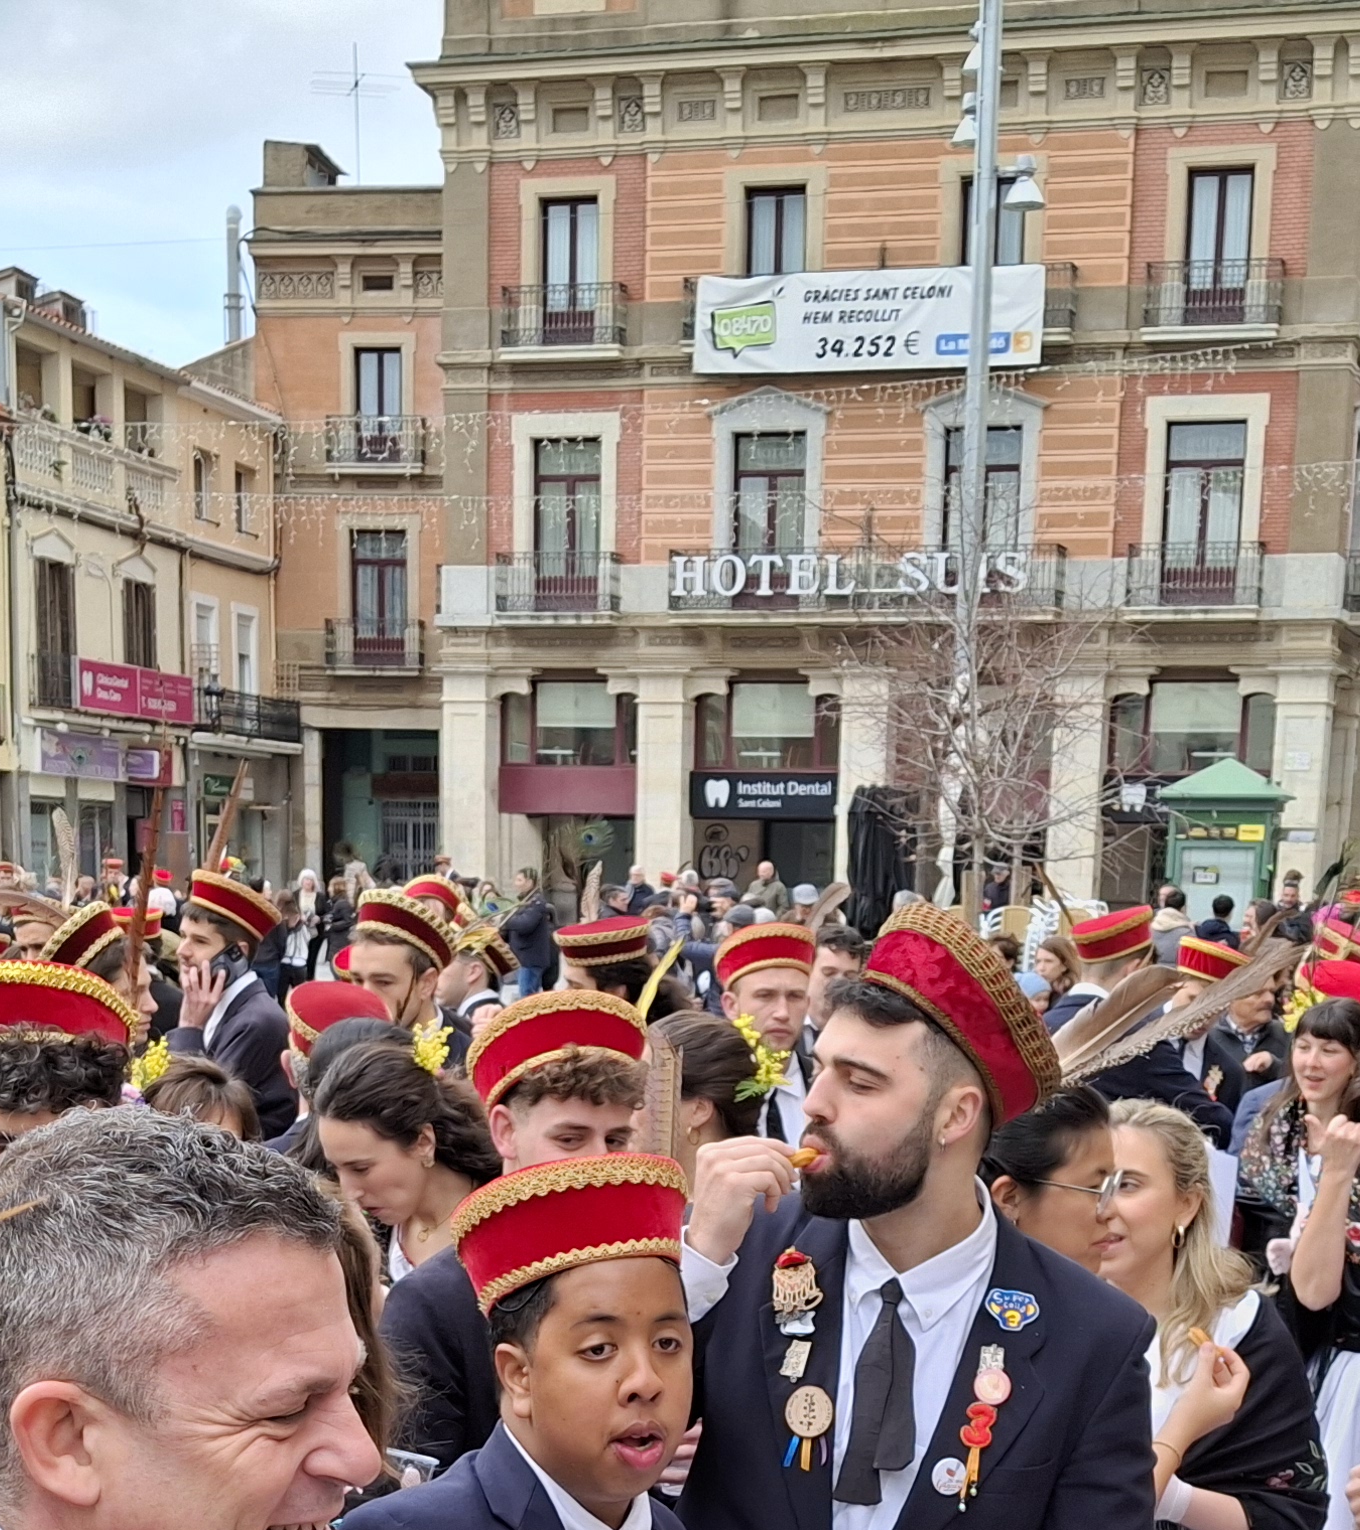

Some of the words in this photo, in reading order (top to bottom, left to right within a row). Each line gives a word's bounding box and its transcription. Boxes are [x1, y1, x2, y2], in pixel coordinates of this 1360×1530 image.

[863, 286, 899, 301] SANT
[903, 285, 953, 300] CELONI
[802, 311, 833, 324] HEM
[837, 308, 902, 324] RECOLLIT
[720, 315, 772, 337] 08470
[815, 334, 896, 358] 34.252
[903, 330, 921, 355] €
[940, 338, 956, 350] La
[671, 553, 856, 597] HOTEL
[738, 780, 785, 796] Institut
[787, 780, 832, 796] Dental
[737, 798, 756, 808] Sant
[757, 798, 782, 808] Celoni
